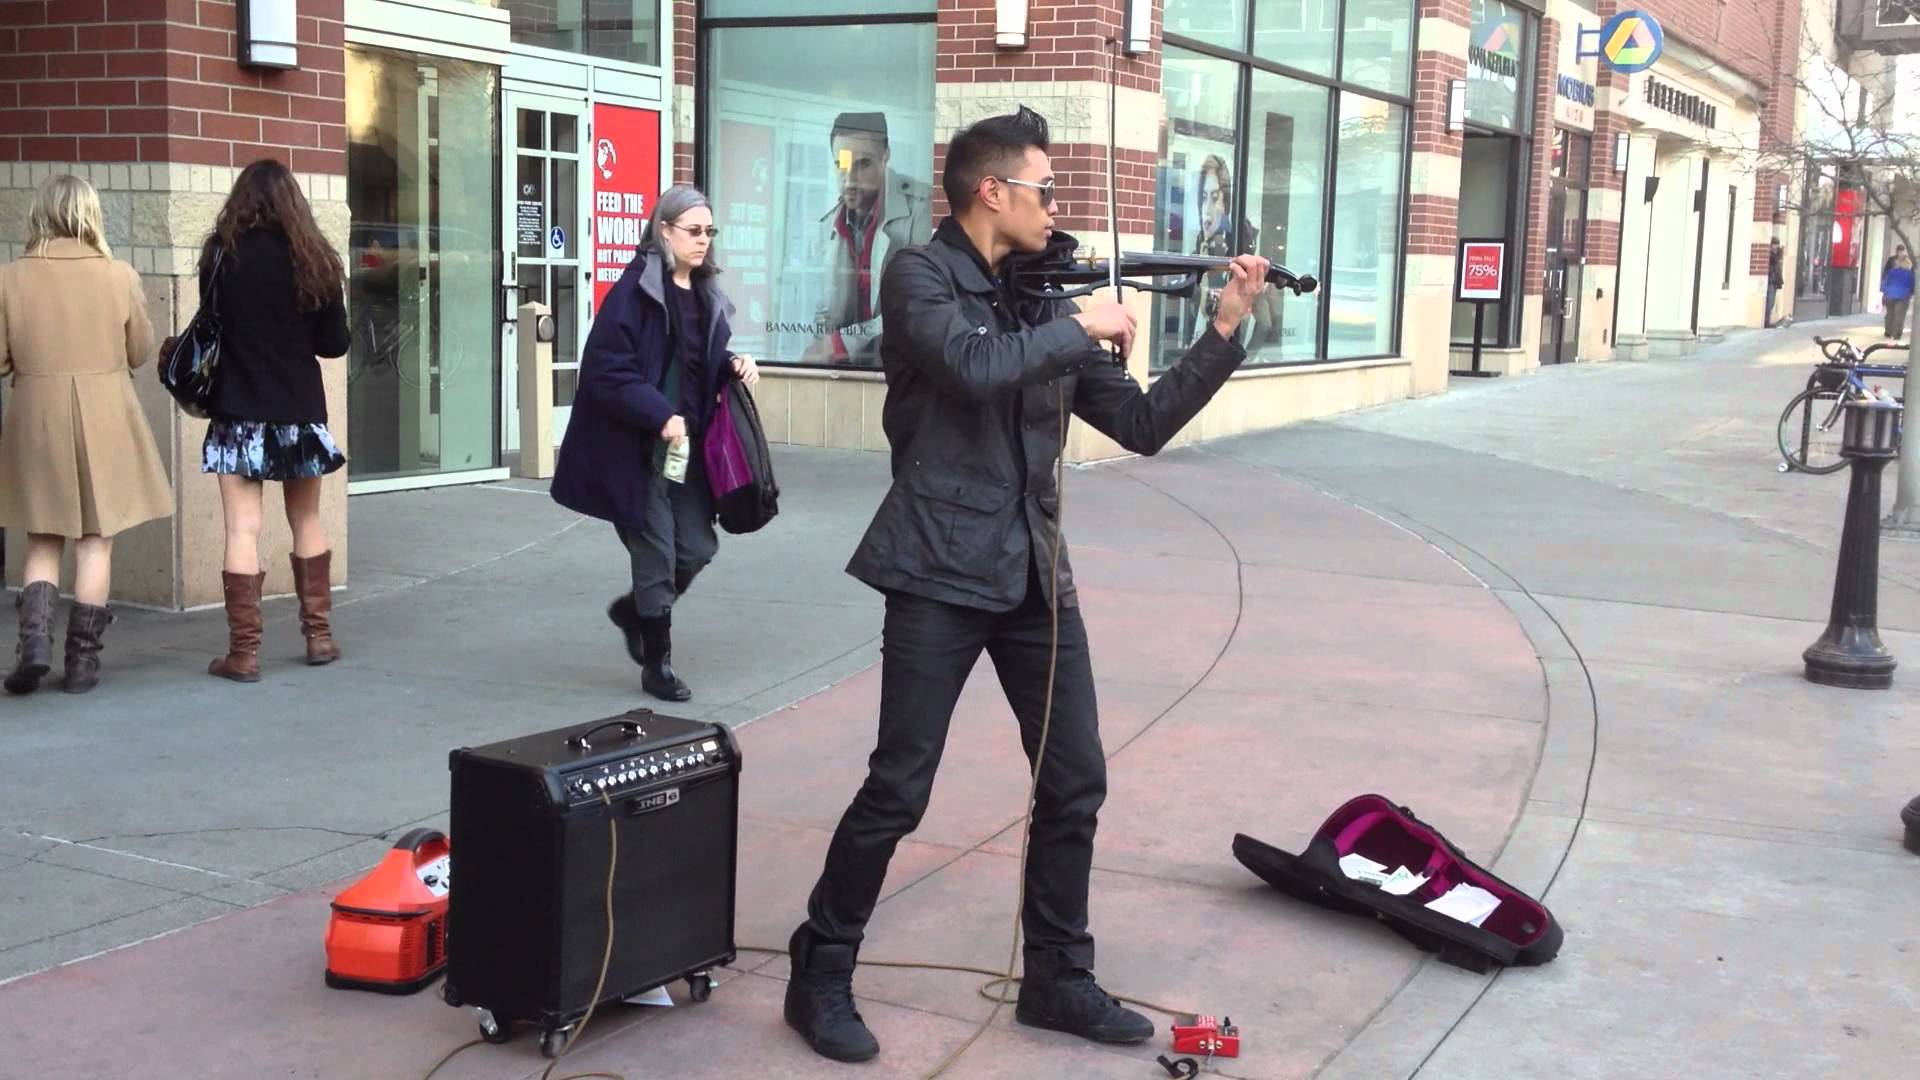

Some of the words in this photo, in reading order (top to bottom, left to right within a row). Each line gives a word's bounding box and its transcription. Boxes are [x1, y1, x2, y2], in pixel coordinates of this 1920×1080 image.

[597, 191, 621, 212] FEED
[623, 193, 643, 214] THE
[596, 248, 612, 263] NOT
[1468, 264, 1498, 277] 75%
[766, 321, 815, 335] BANANA
[637, 794, 666, 810] INE
